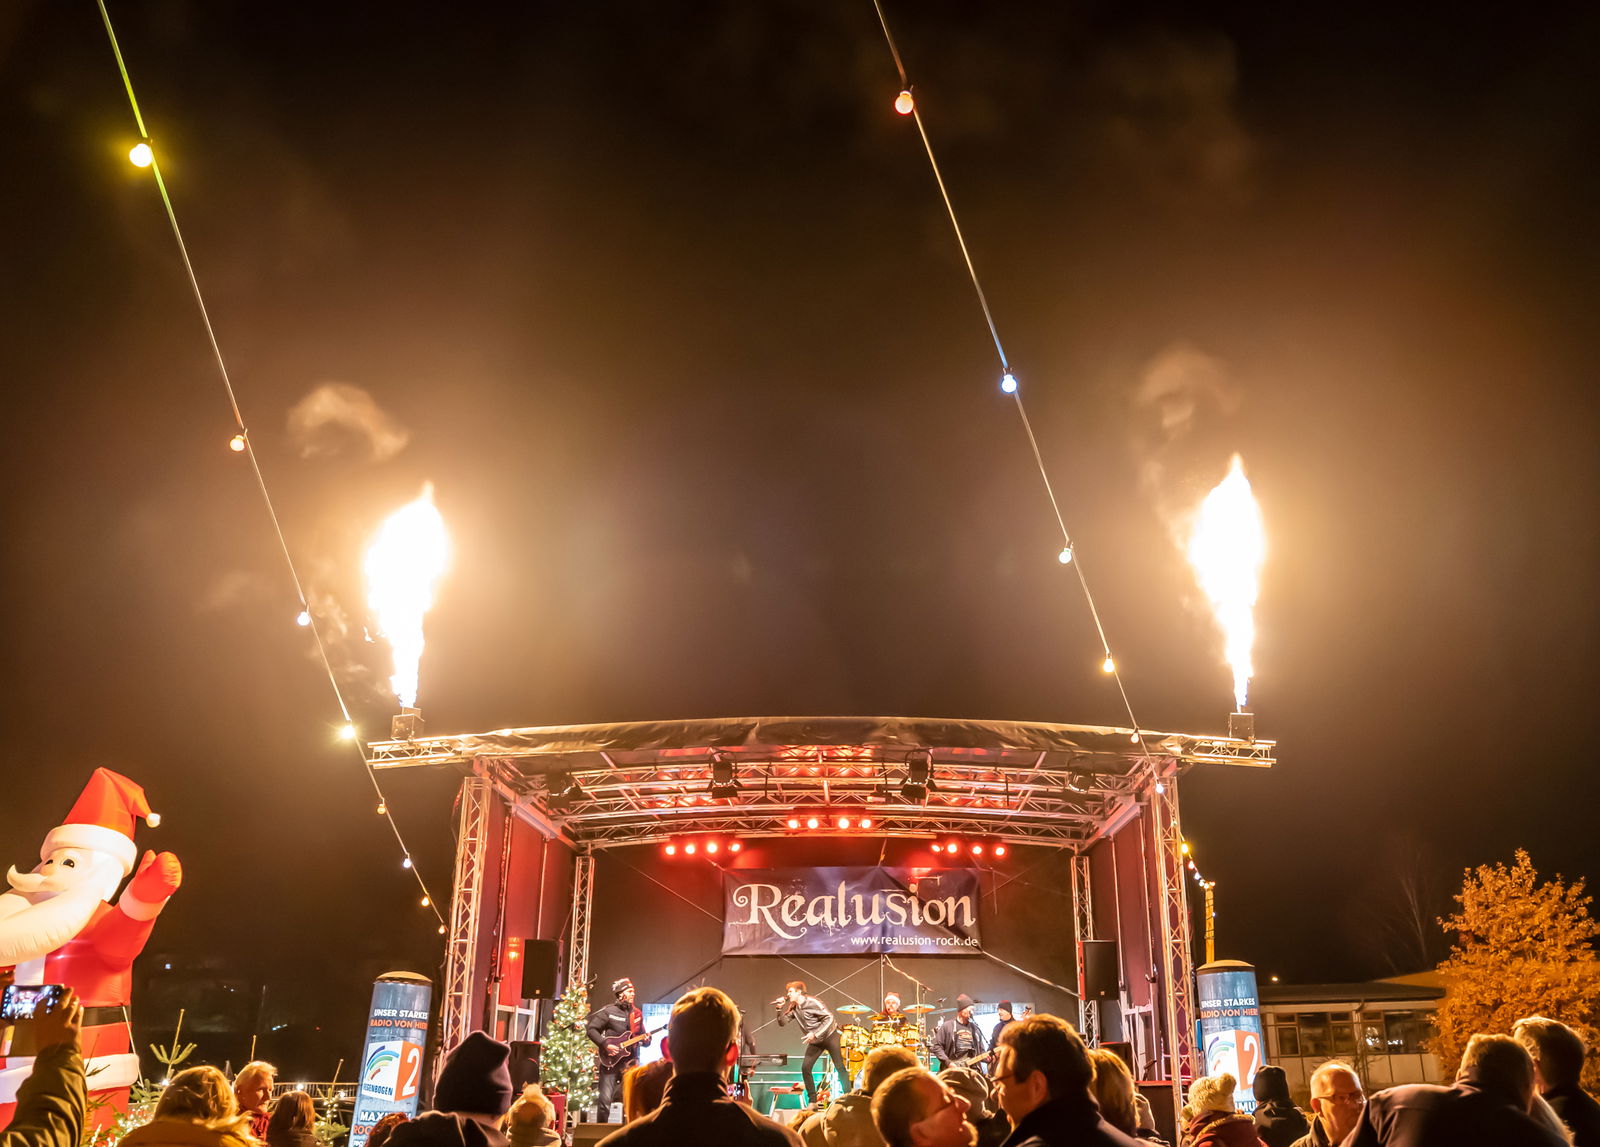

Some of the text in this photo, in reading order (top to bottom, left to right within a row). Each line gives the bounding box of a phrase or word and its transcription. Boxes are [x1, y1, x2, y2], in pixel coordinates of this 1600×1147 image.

[730, 880, 976, 940] Realusion
[850, 933, 979, 948] www.realusion-rock.de
[1201, 998, 1255, 1008] UNSER STARKES
[373, 1008, 398, 1017] UNSER
[1221, 1009, 1240, 1017] VON
[394, 1019, 413, 1028] VON
[1243, 1035, 1258, 1085] 2
[402, 1047, 420, 1097] 2
